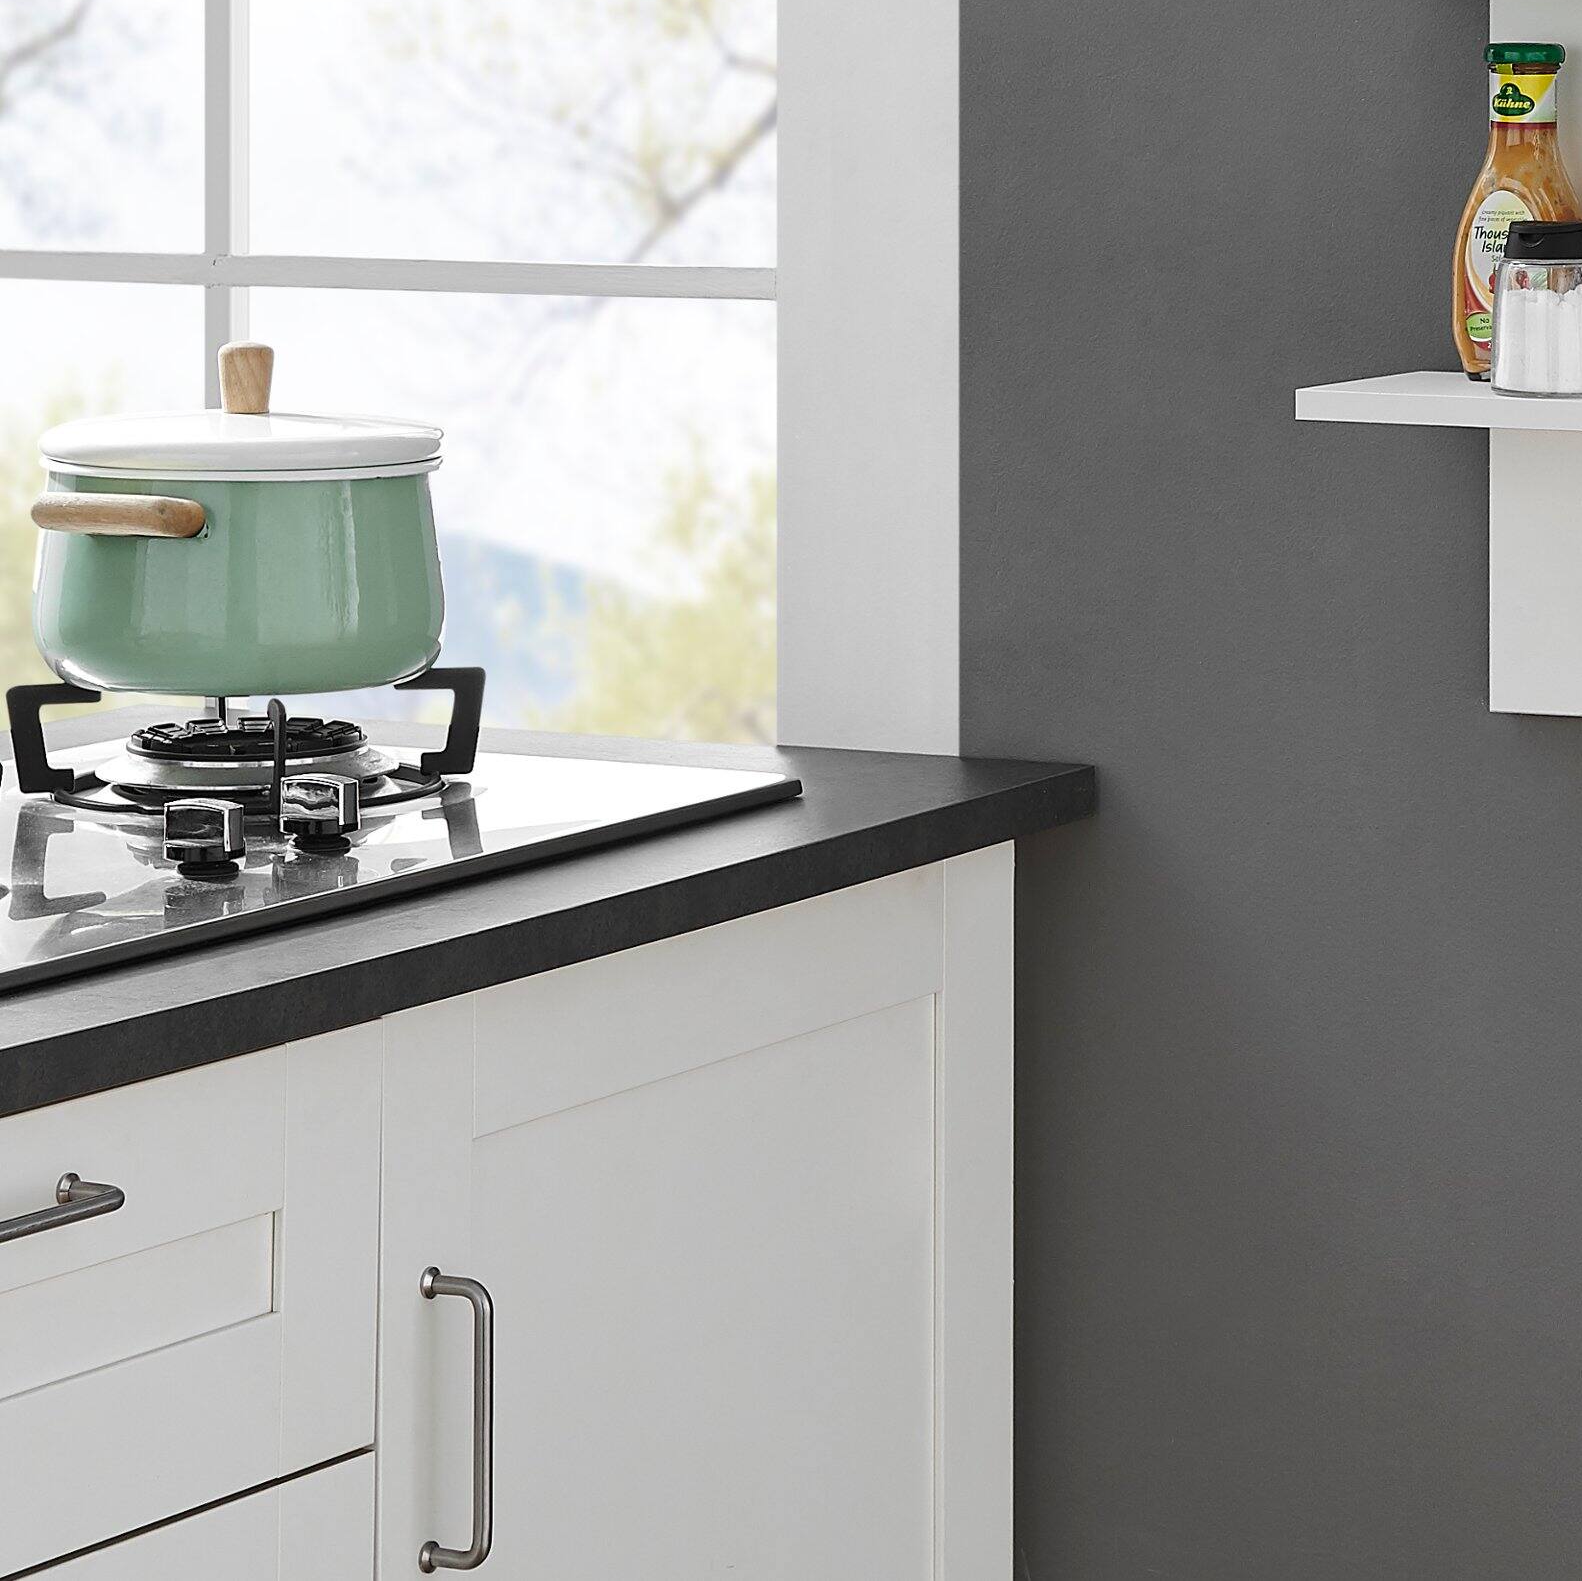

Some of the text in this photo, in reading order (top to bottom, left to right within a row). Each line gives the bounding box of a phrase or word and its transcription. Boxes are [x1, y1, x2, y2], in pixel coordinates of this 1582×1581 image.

[1494, 98, 1531, 109] Kühne
[1474, 226, 1509, 239] Thous
[1481, 240, 1504, 253] Isla
